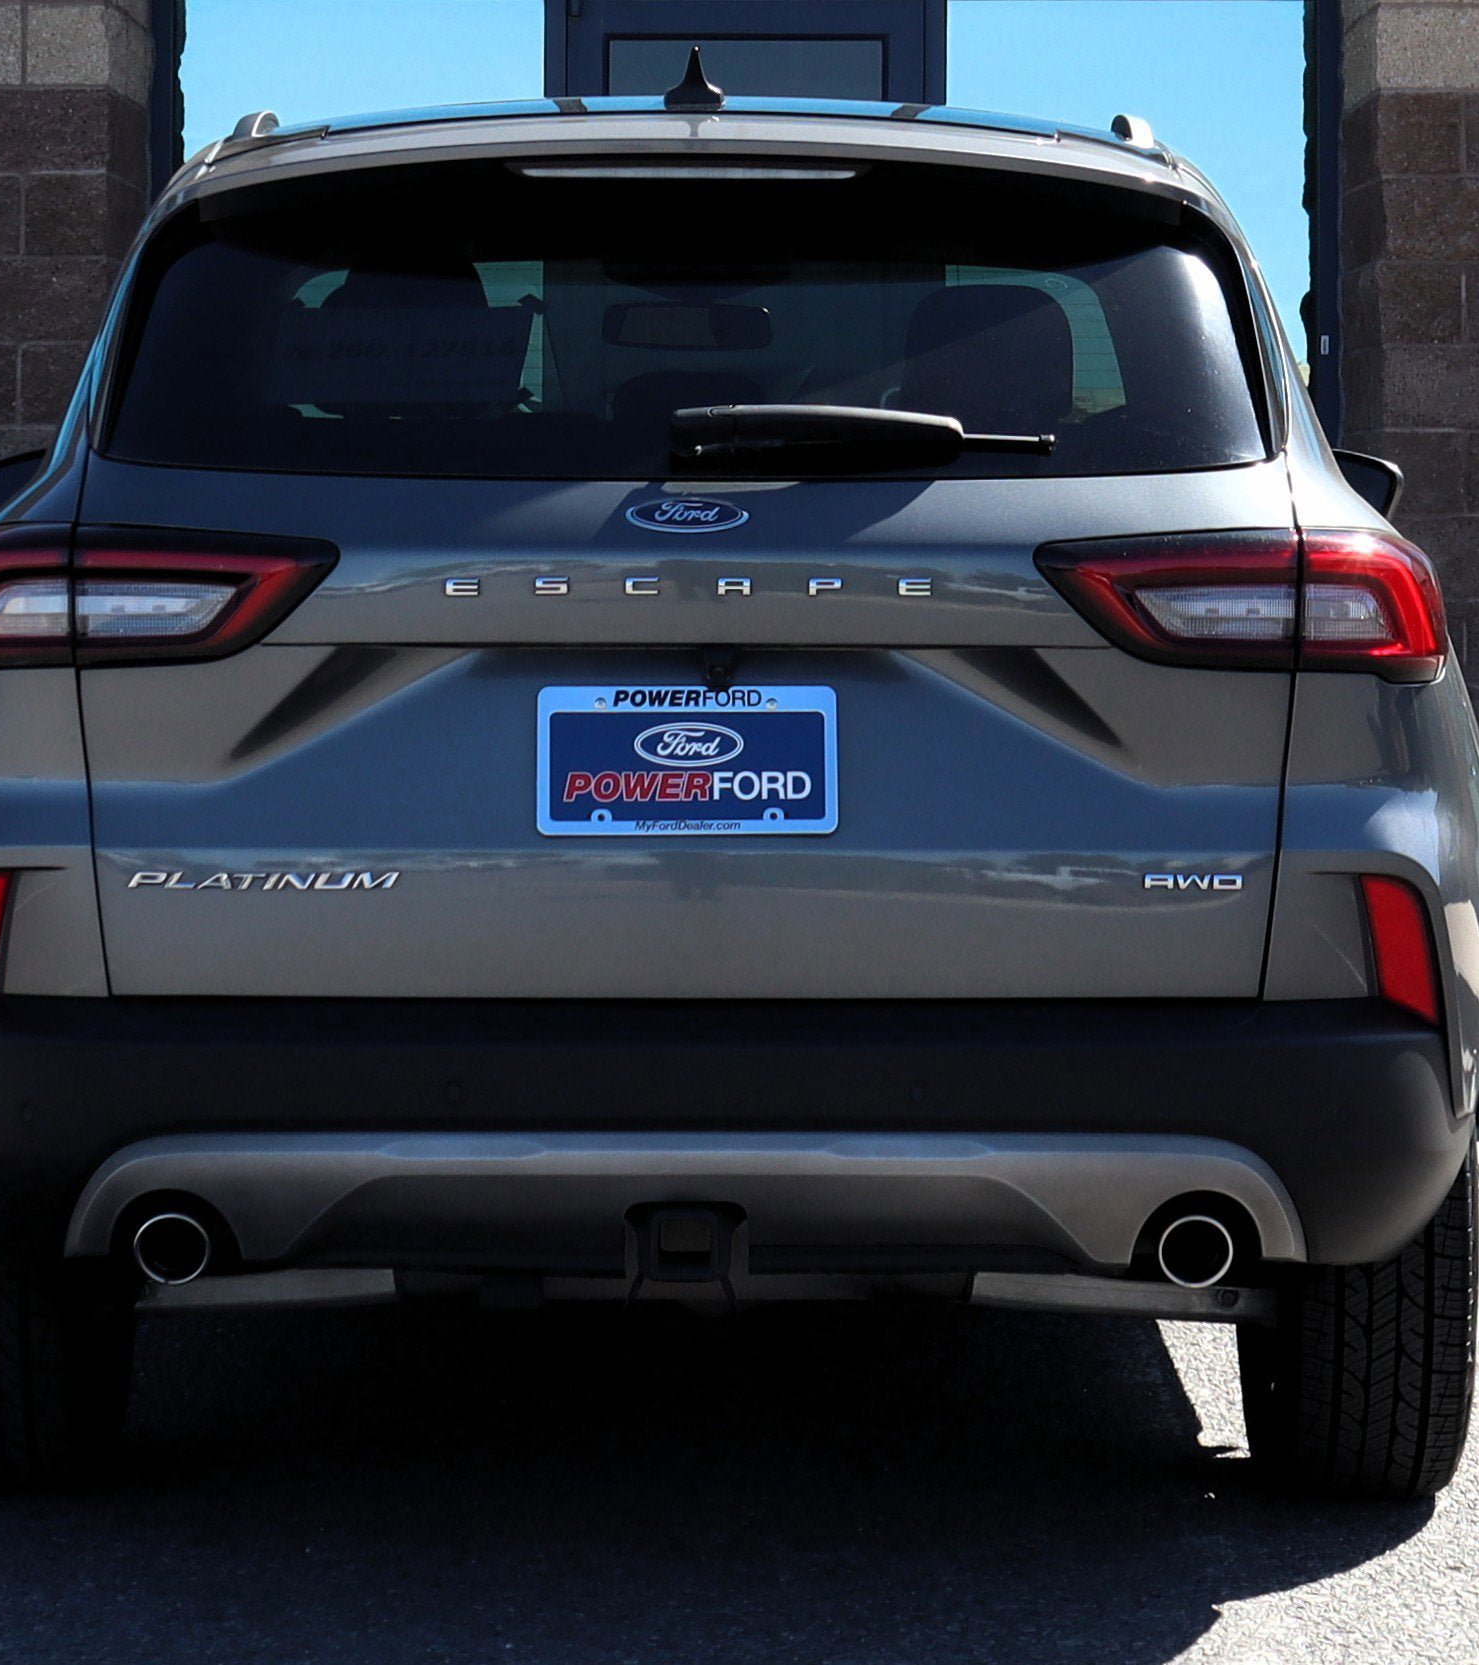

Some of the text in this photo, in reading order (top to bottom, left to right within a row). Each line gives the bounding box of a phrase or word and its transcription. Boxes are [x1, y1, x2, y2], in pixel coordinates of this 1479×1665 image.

[654, 501, 720, 524] Ford
[445, 576, 933, 597] ESCAPE
[656, 730, 722, 757] Ford
[634, 820, 742, 833] MyFordDealer.com
[127, 871, 401, 891] PLATINUM
[1144, 873, 1243, 890] AWD
